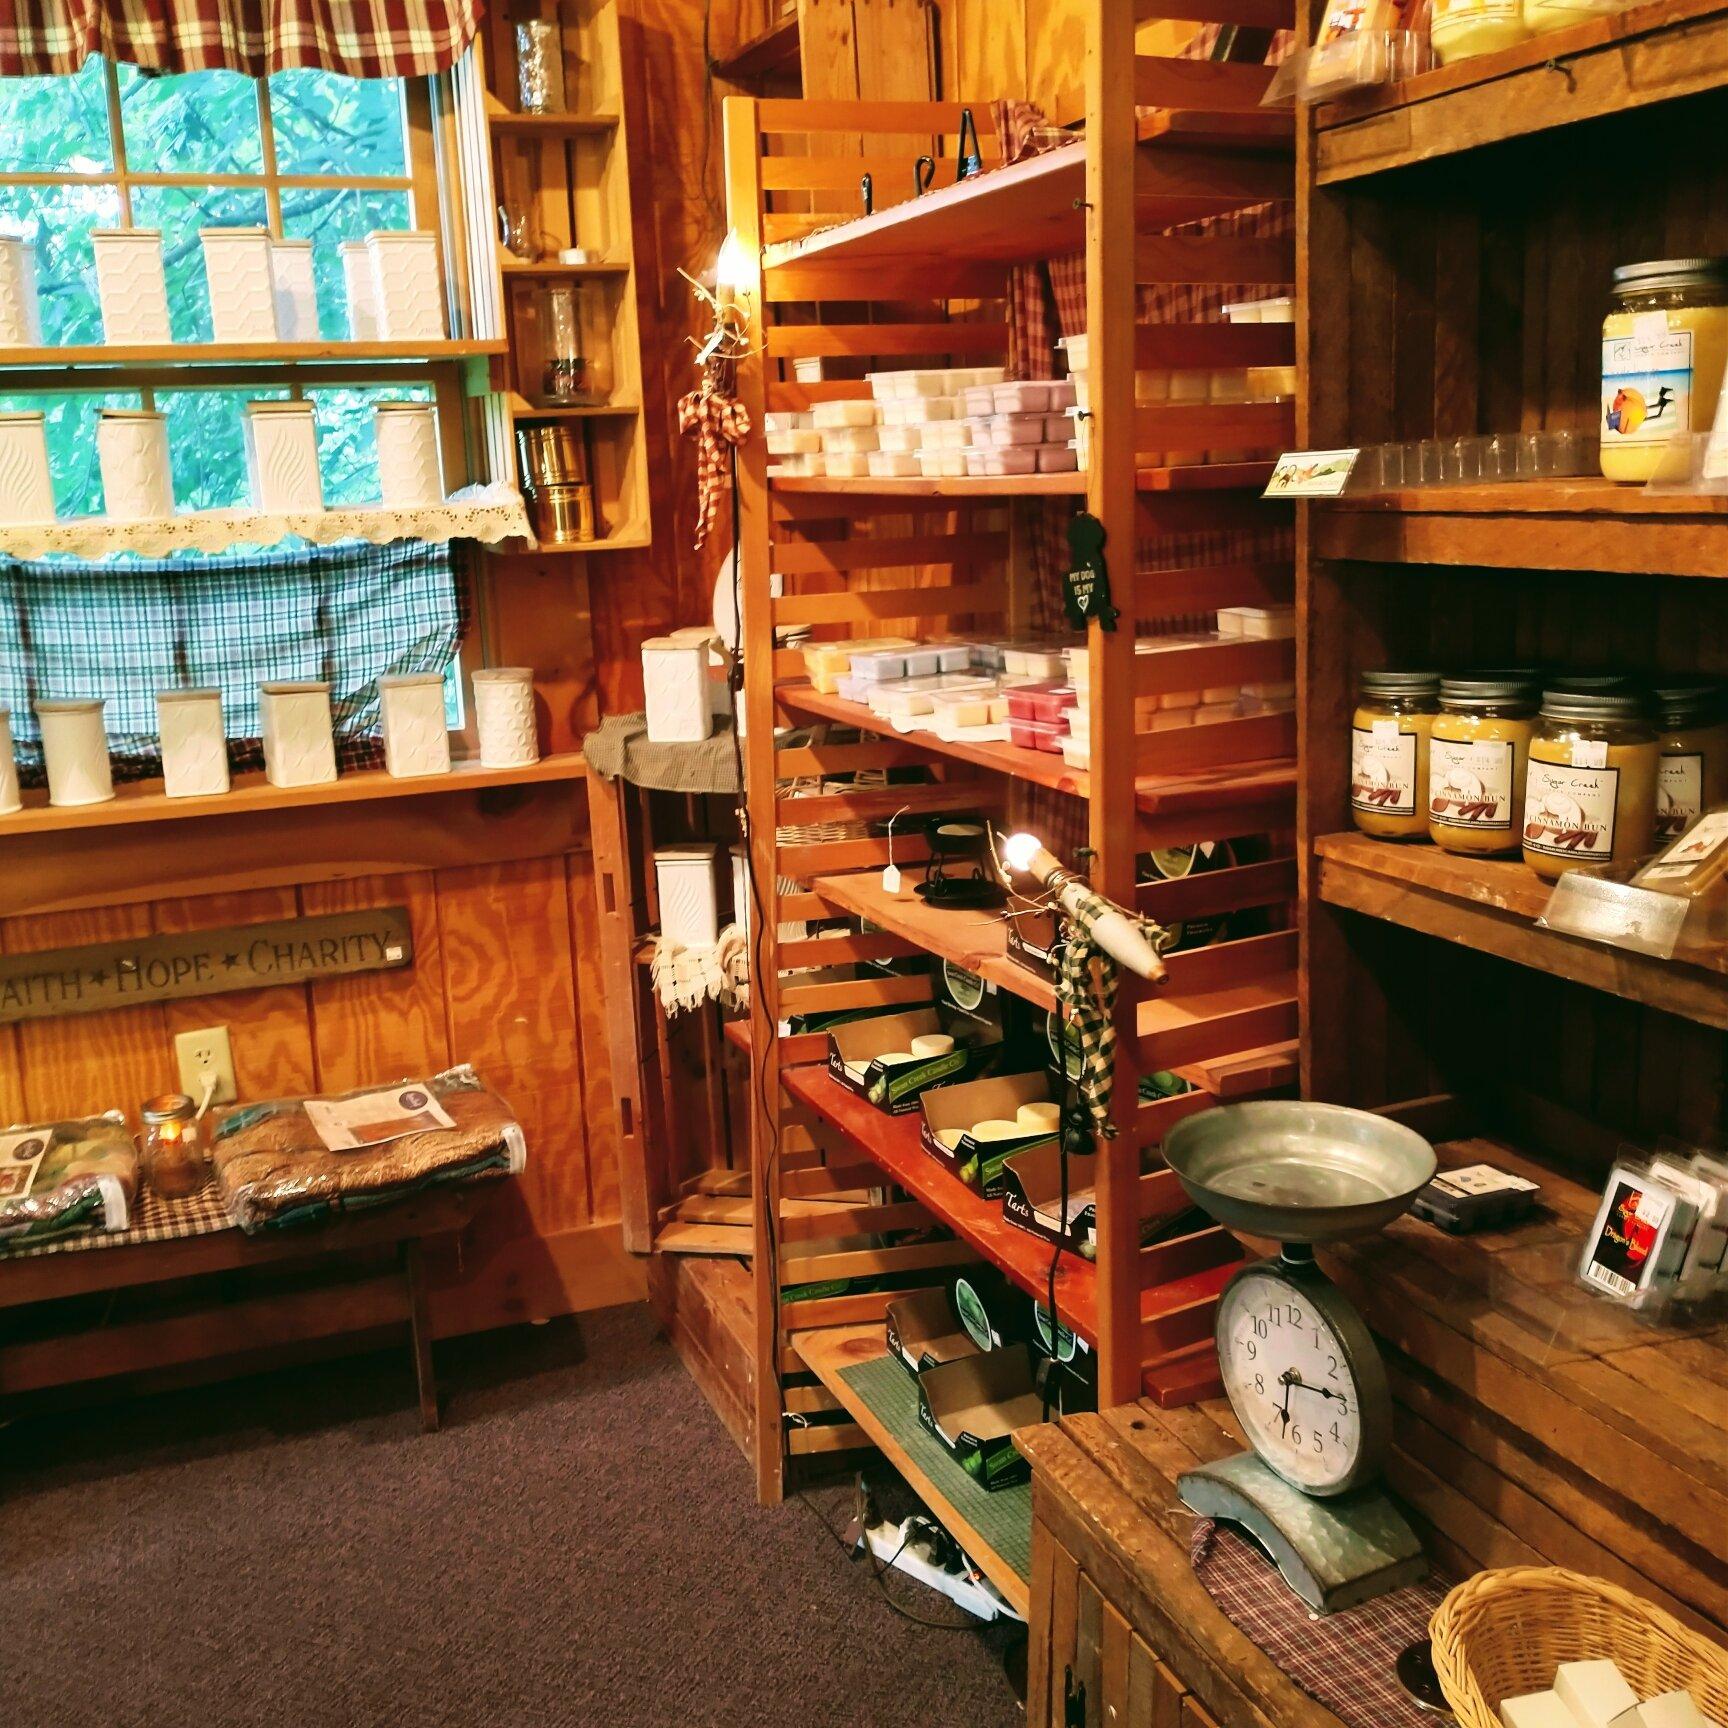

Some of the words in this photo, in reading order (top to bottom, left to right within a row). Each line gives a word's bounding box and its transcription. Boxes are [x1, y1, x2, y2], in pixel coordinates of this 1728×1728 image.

[1069, 571, 1080, 582] MY
[1080, 569, 1095, 581] DOG
[1074, 585, 1082, 596] IS
[1082, 583, 1094, 594] MY
[1570, 778, 1600, 789] Creek
[1484, 795, 1506, 803] BUN
[1529, 814, 1579, 831] CINNAMON
[1584, 823, 1608, 832] BUN
[0, 966, 83, 1010] AITH
[114, 951, 215, 994] HOPE
[247, 930, 393, 977] CHARITY
[1005, 1191, 1029, 1217] Tarts
[1266, 1303, 1282, 1328] 11
[1285, 1304, 1303, 1330] 12
[1251, 1315, 1268, 1340] 10
[1311, 1327, 1320, 1350] 1
[1246, 1340, 1257, 1361] 9
[1327, 1355, 1338, 1380] 2
[1254, 1373, 1265, 1395] 8
[1272, 1402, 1283, 1423] 7
[1337, 1393, 1348, 1416] 3
[1291, 1424, 1302, 1445] 6
[1313, 1430, 1323, 1454] 5
[1329, 1421, 1341, 1444] 4
